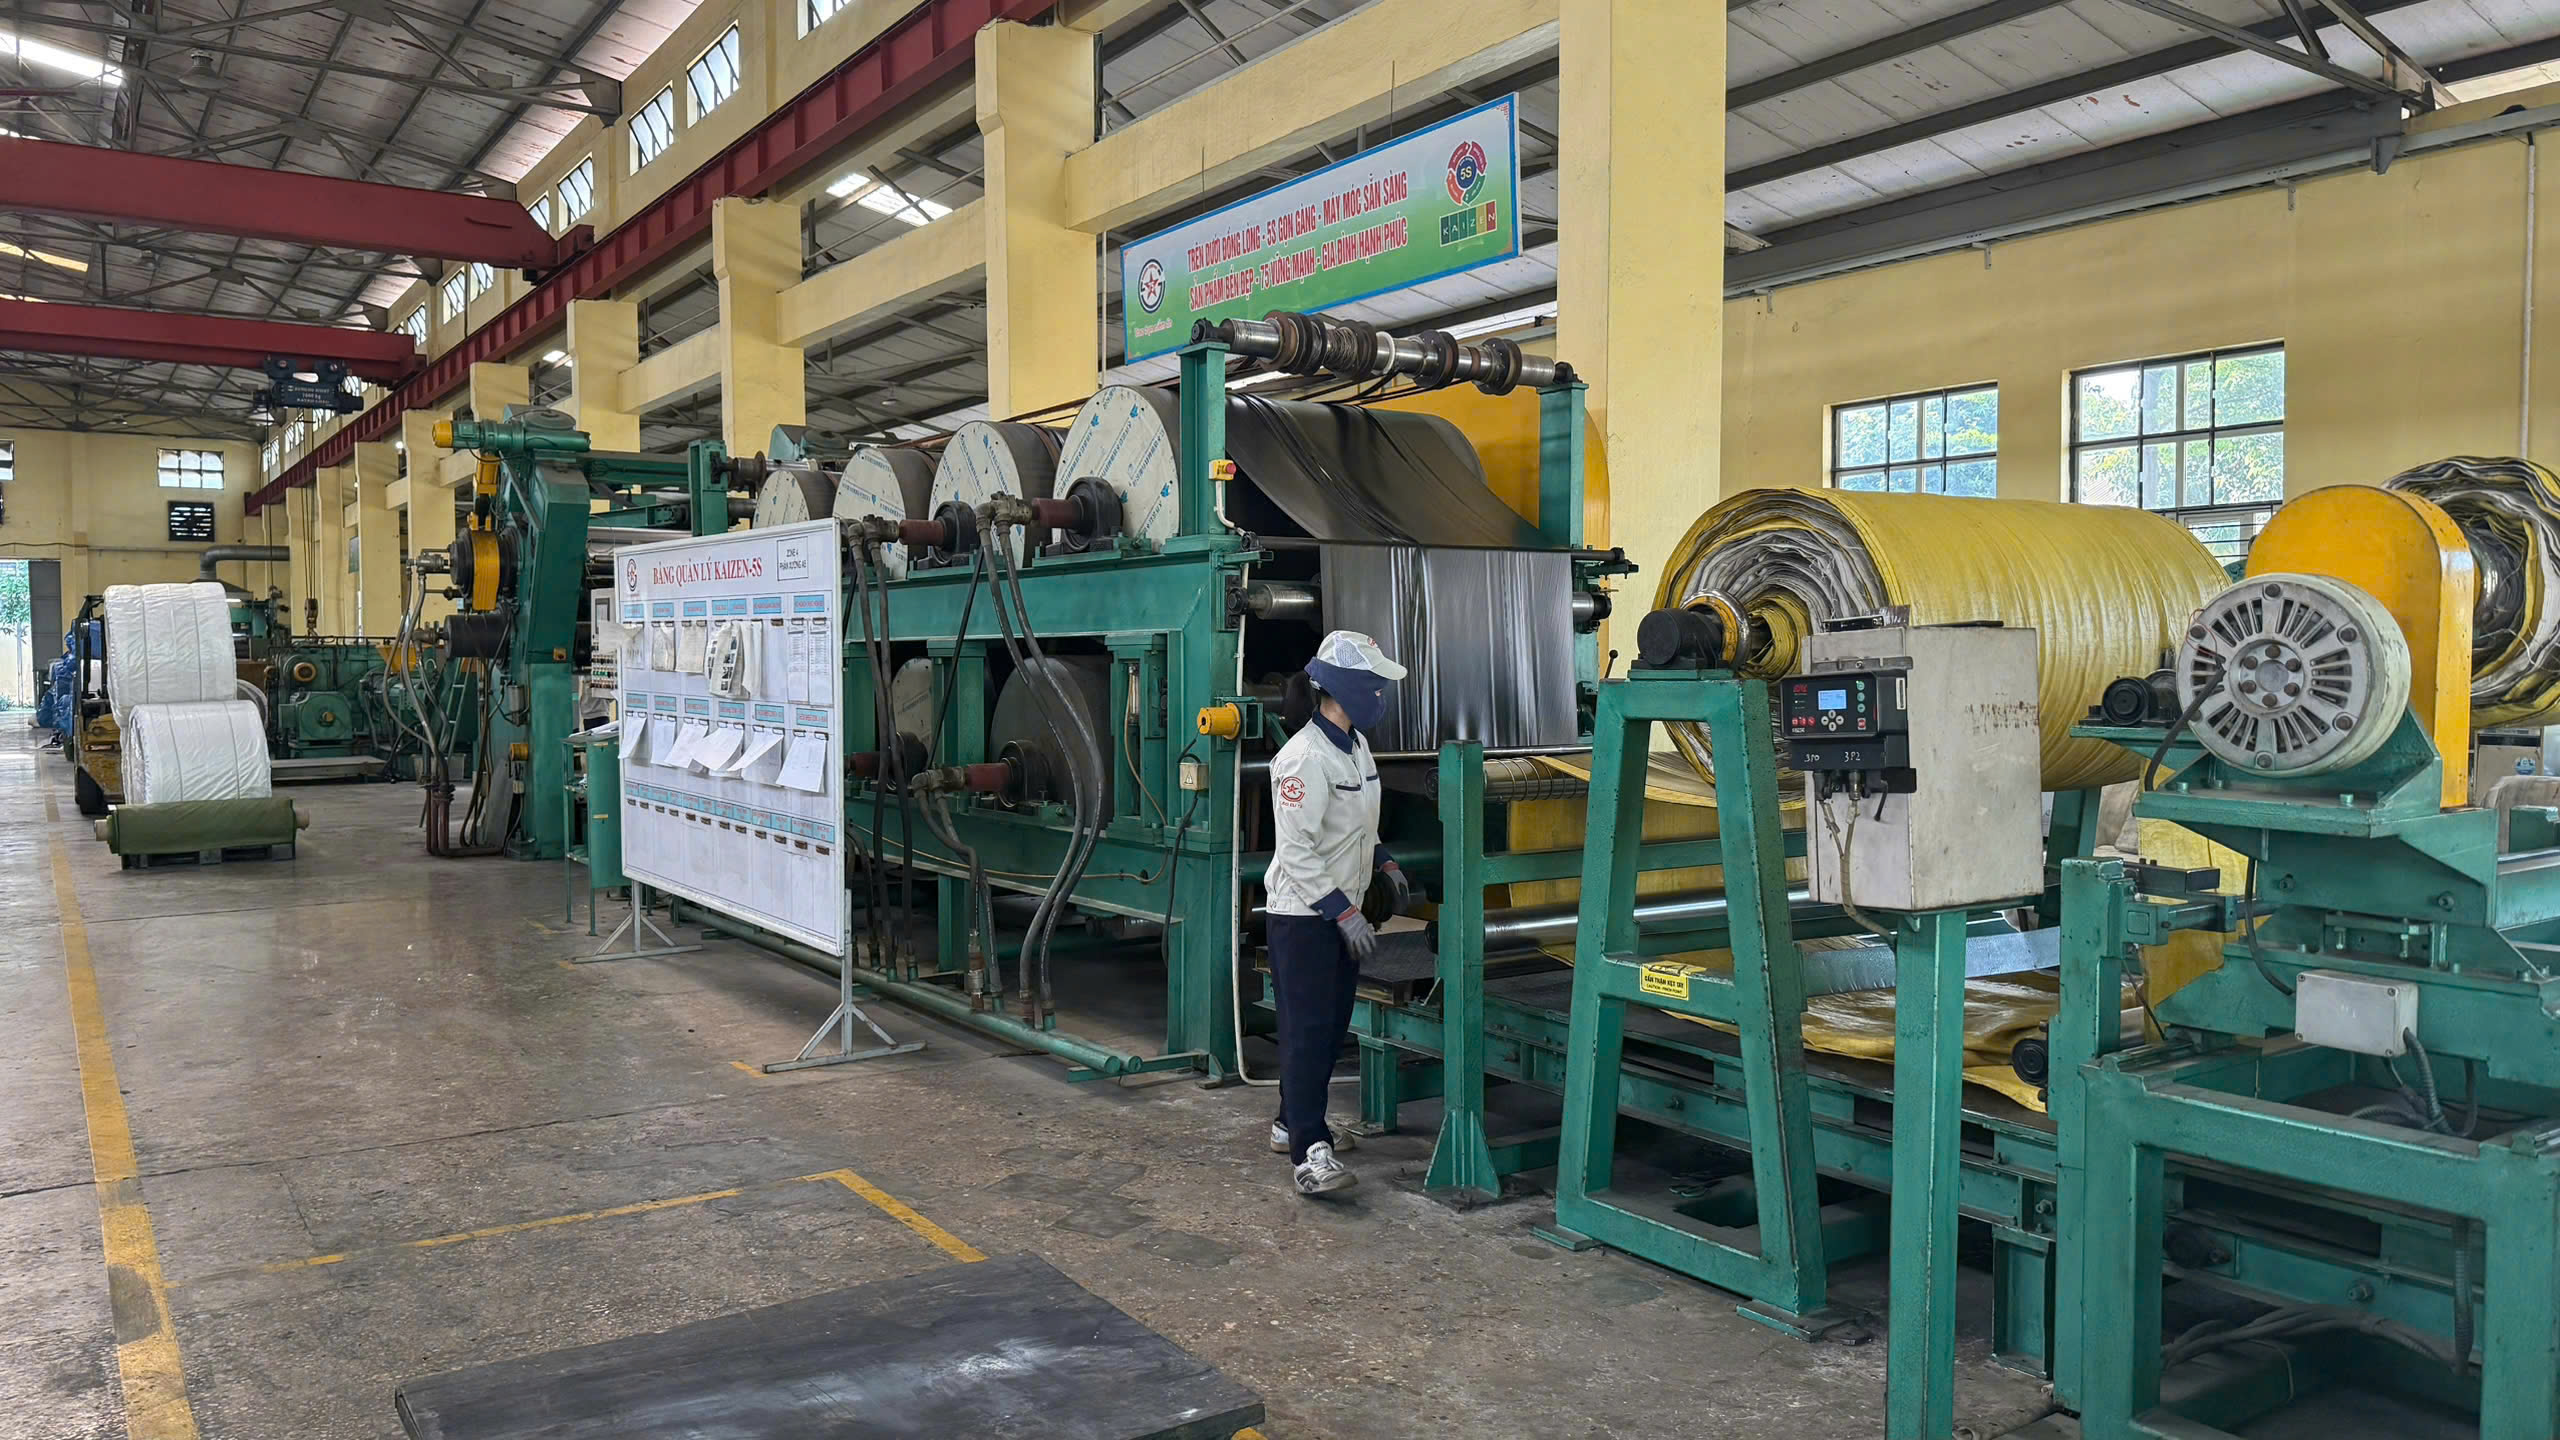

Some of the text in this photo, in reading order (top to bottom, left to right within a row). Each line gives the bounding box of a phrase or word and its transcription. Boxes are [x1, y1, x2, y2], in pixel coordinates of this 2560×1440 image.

[1460, 166, 1472, 180] 5S
[1187, 241, 1204, 272] TRÊN
[1242, 222, 1260, 254] LÒNG
[1266, 219, 1276, 246] 5S
[1278, 213, 1294, 247] GỌN
[1295, 203, 1317, 236] GÀNG
[1323, 191, 1341, 227] MÁY
[1342, 184, 1362, 220] MÓC
[1383, 169, 1407, 206] SÀNG
[1443, 213, 1496, 236] KAIZEN
[1190, 276, 1204, 311] SẢN
[1240, 268, 1254, 300] ĐẸP
[1292, 247, 1315, 284] MẠNH
[1322, 241, 1336, 270] GIA
[1336, 231, 1358, 265] ĐÌNH
[1358, 225, 1383, 264] HẠNH
[1384, 212, 1408, 251] PHÚC
[653, 556, 763, 588] BẢNG QUẢN LÝ KAIZEN-5S
